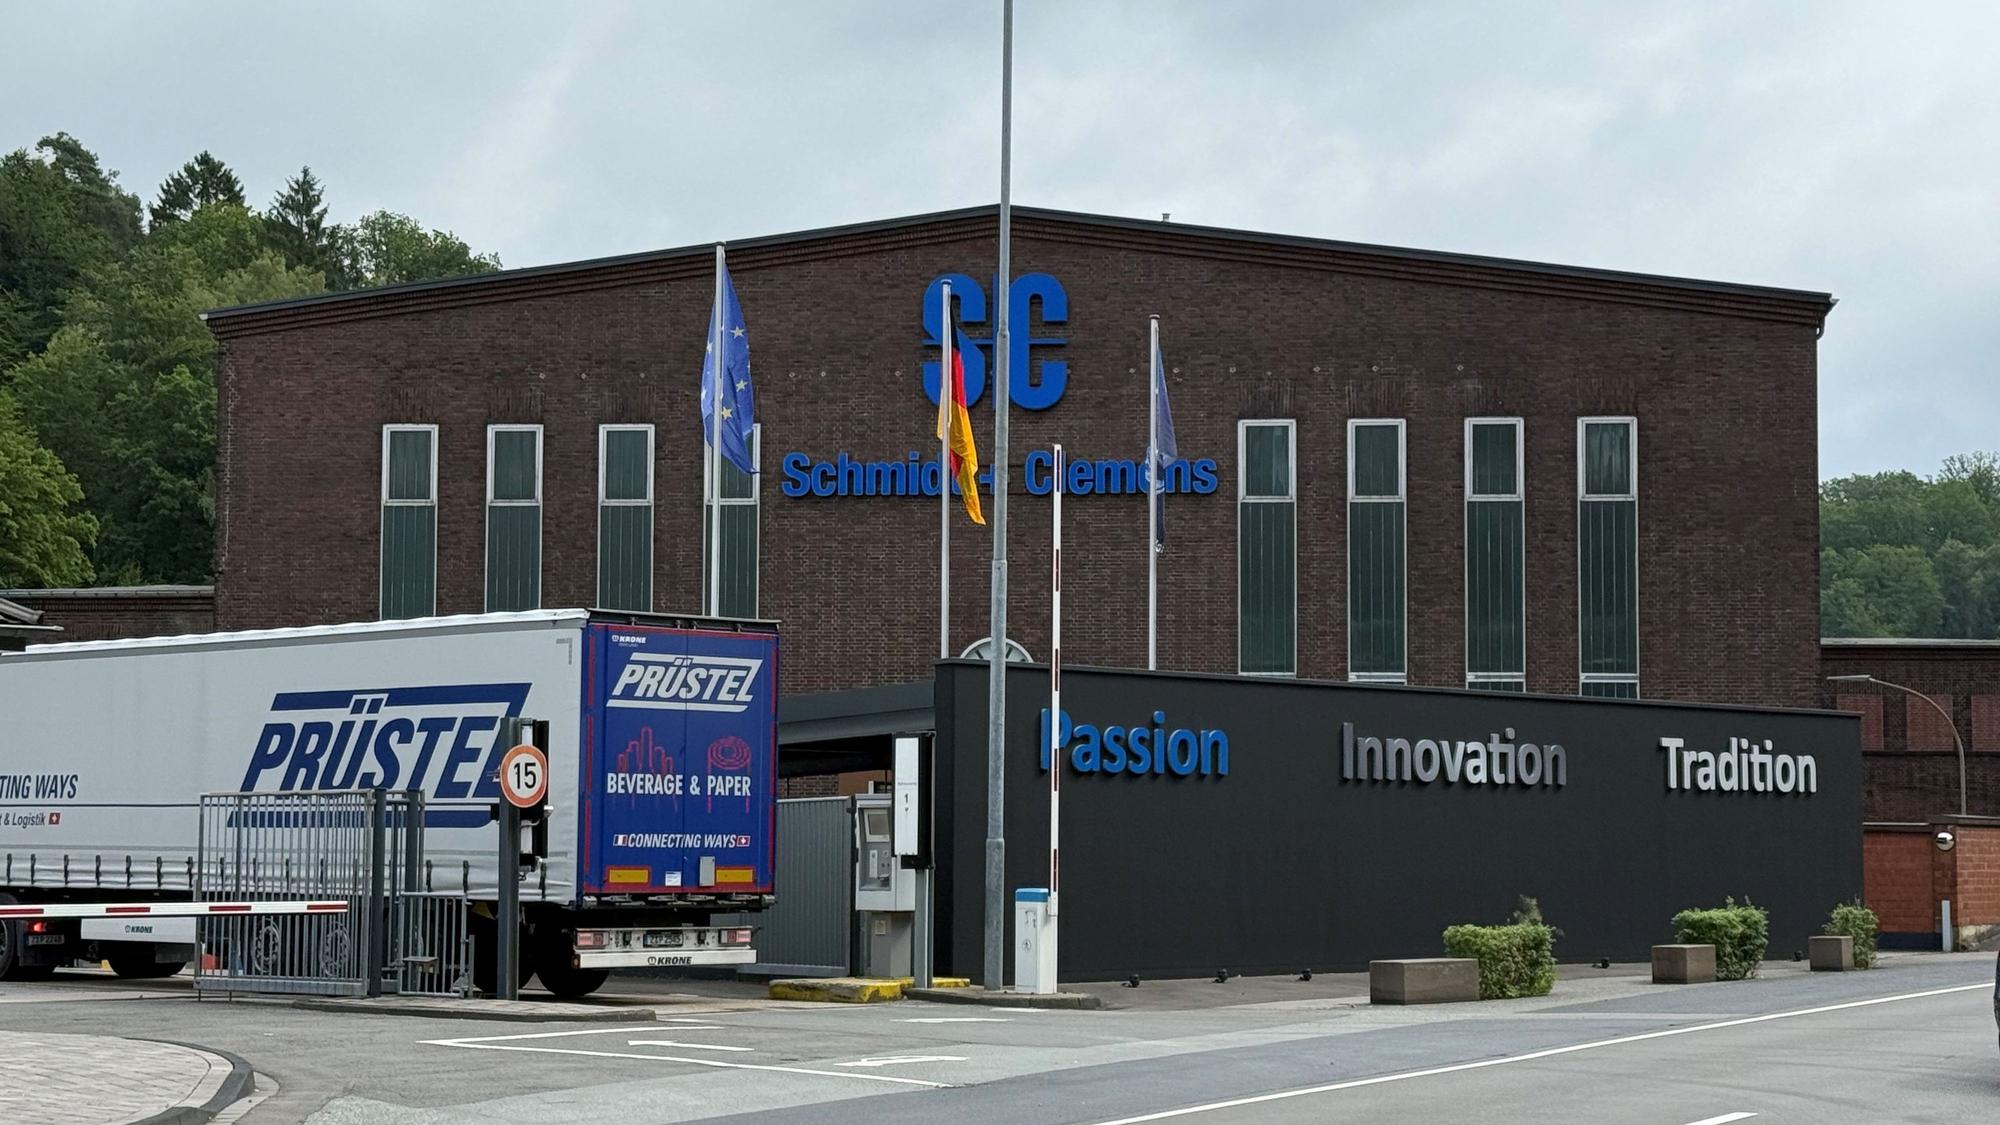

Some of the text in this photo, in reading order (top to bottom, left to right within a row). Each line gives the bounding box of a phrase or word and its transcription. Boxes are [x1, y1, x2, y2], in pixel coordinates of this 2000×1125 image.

[611, 656, 759, 702] PRÜSTEL
[1040, 708, 1230, 776] Passion
[1342, 721, 1567, 786] Innovation
[513, 762, 537, 790] 15
[1660, 736, 1818, 794] Tradition
[35, 774, 79, 799] WAYS
[607, 772, 751, 796] BEVERAGE & PAPER
[4, 812, 10, 826] &
[12, 812, 46, 829] Logistik
[628, 833, 737, 850] CONNECTING WAYS
[131, 926, 153, 934] KRONE
[657, 956, 693, 965] KRONE
